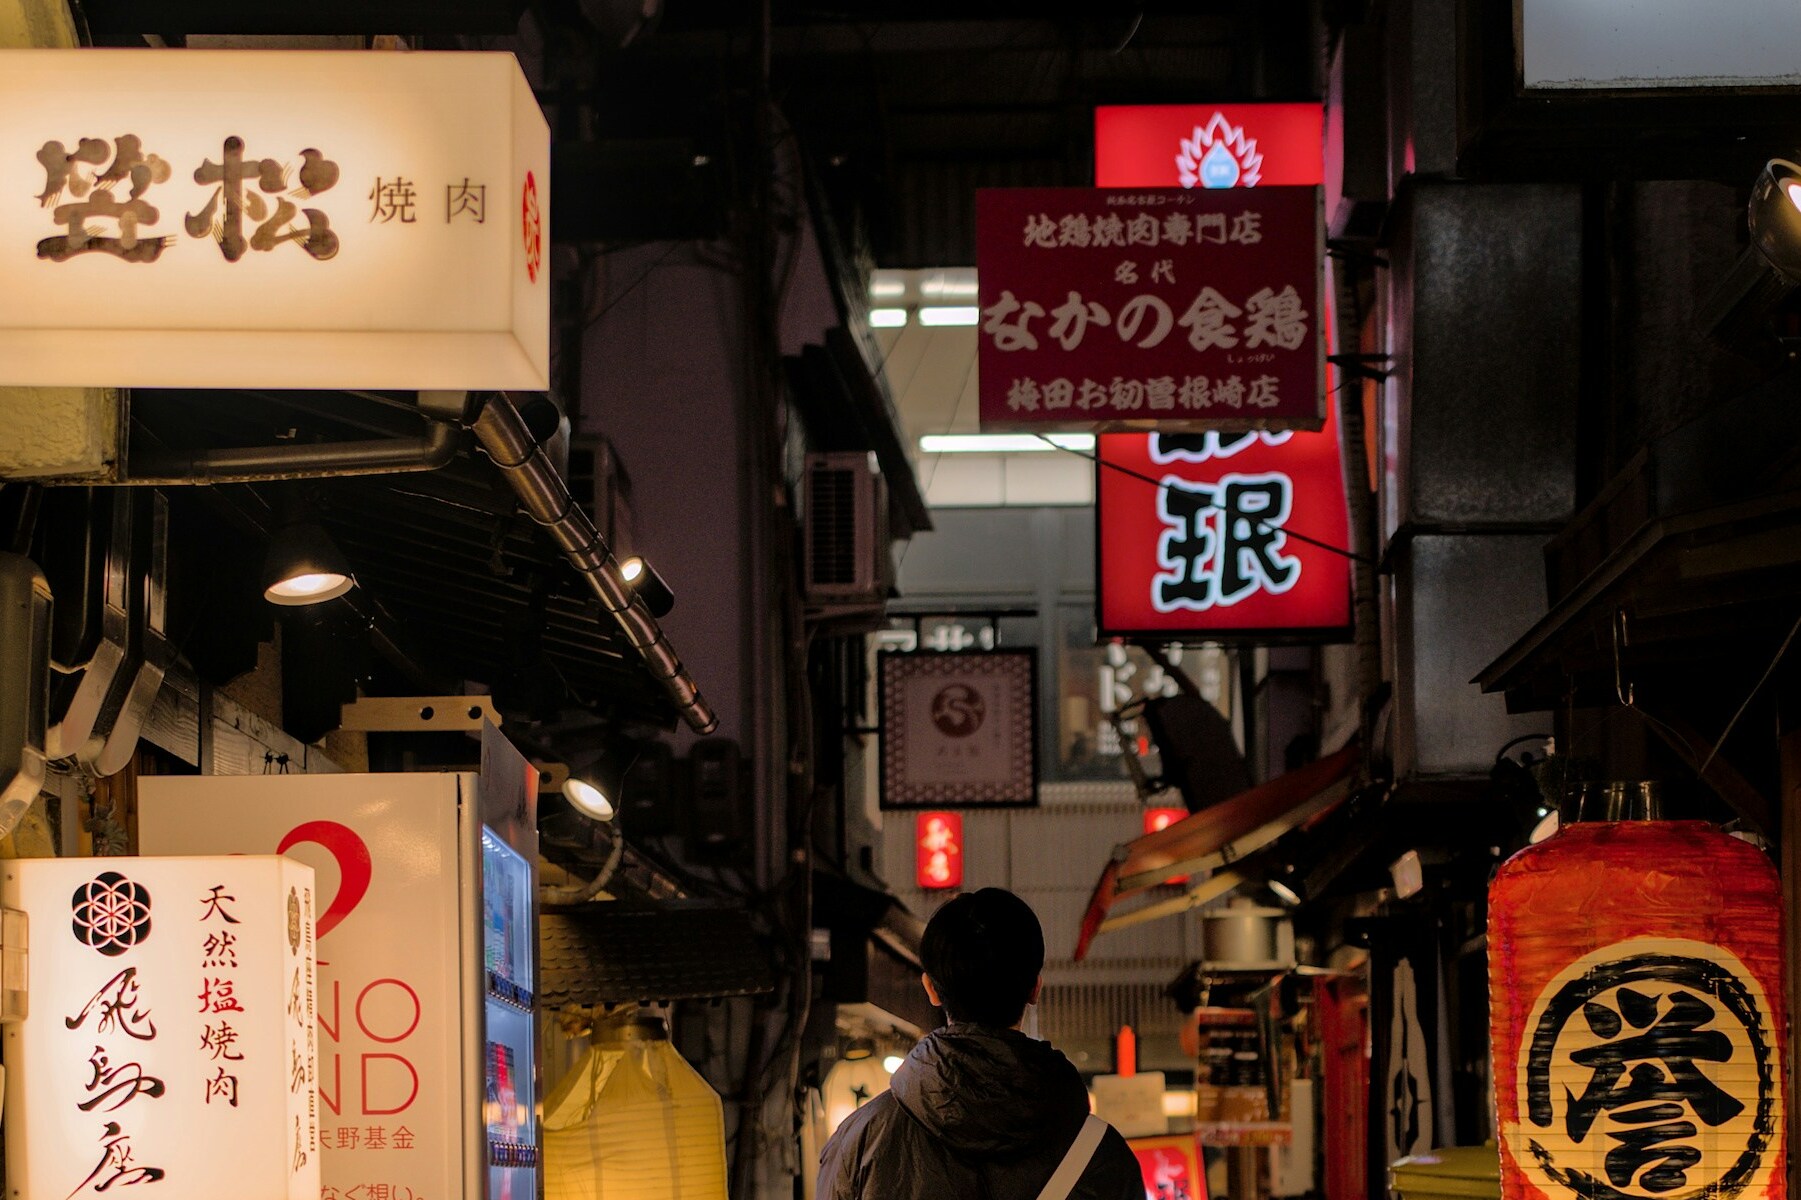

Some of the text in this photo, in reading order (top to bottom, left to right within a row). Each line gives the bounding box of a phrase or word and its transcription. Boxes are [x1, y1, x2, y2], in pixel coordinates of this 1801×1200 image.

[369, 176, 487, 225] 焼肉
[1023, 211, 1262, 248] 地鶏焼肉専門店
[1115, 259, 1176, 285] 名代
[984, 285, 1308, 351] なかの食鶏
[198, 885, 245, 1107] 天然塩焼肉
